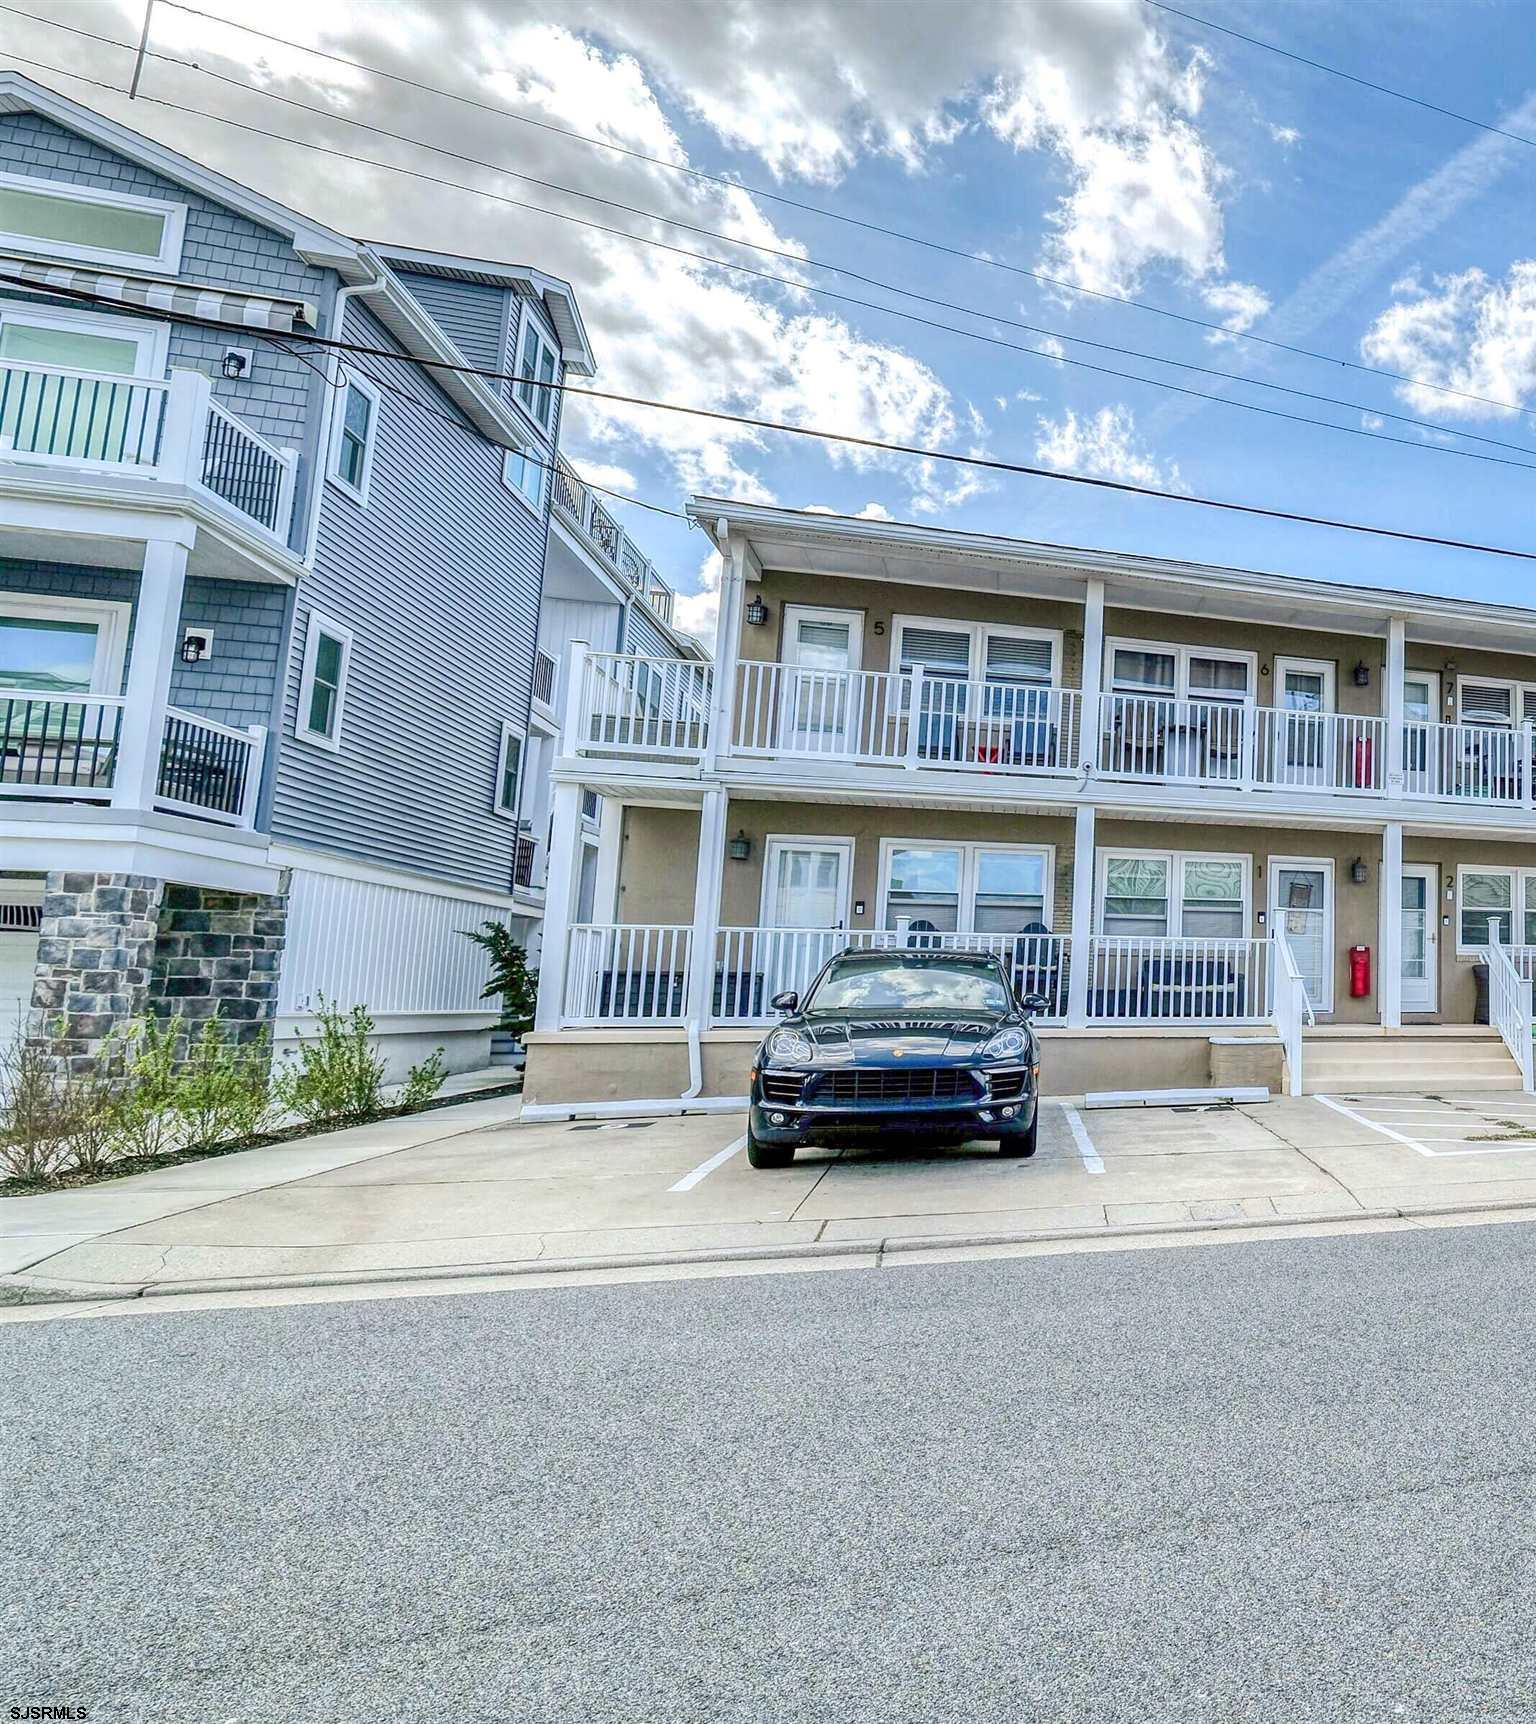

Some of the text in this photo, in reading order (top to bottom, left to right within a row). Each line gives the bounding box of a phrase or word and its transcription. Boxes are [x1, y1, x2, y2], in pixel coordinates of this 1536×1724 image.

[874, 621, 884, 635] 5
[1260, 664, 1269, 676] 6
[1446, 682, 1454, 694] 7
[1257, 865, 1262, 879] 1
[1446, 875, 1454, 888] 2
